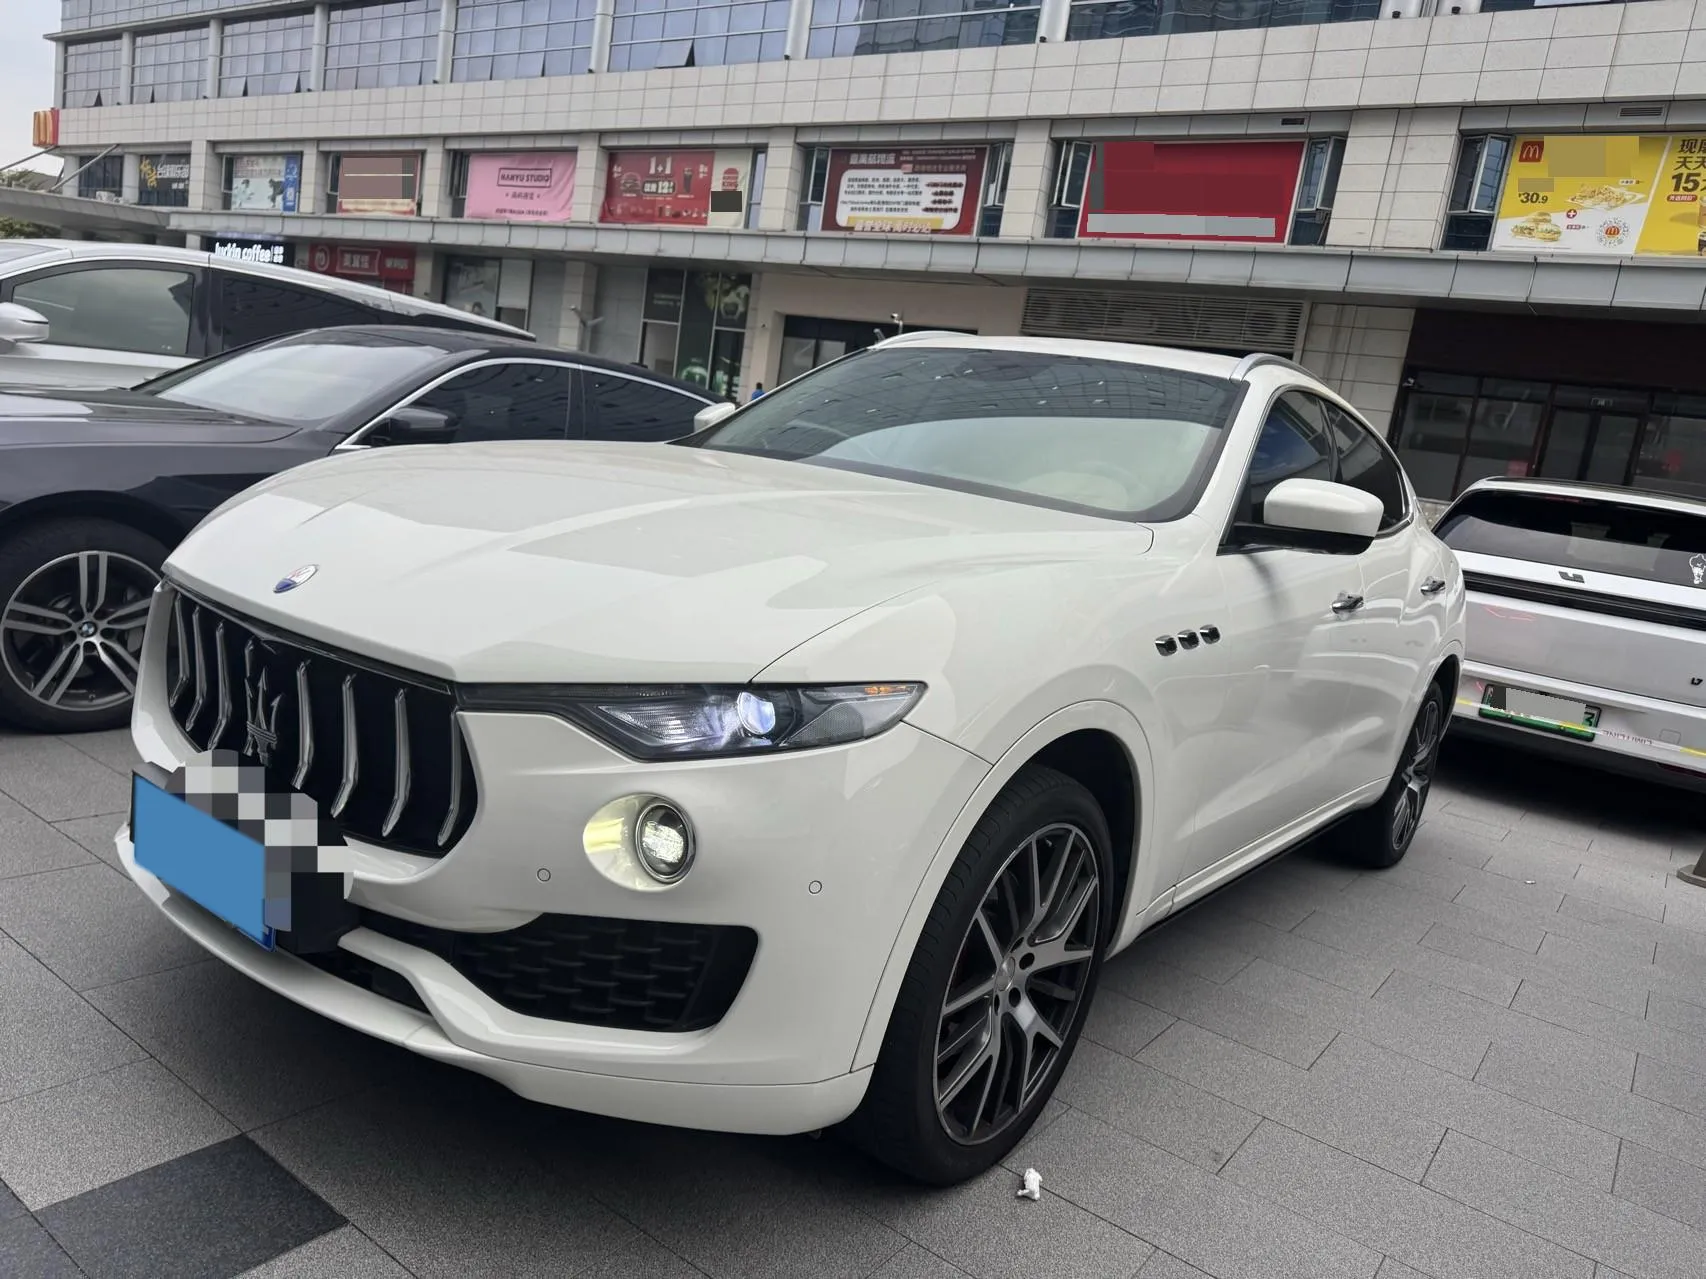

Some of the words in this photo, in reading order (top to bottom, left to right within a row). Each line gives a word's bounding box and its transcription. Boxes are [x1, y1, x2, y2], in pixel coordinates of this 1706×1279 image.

[526, 174, 550, 182] STUDIO
[215, 242, 241, 259] luckin
[242, 244, 271, 262] coffee
